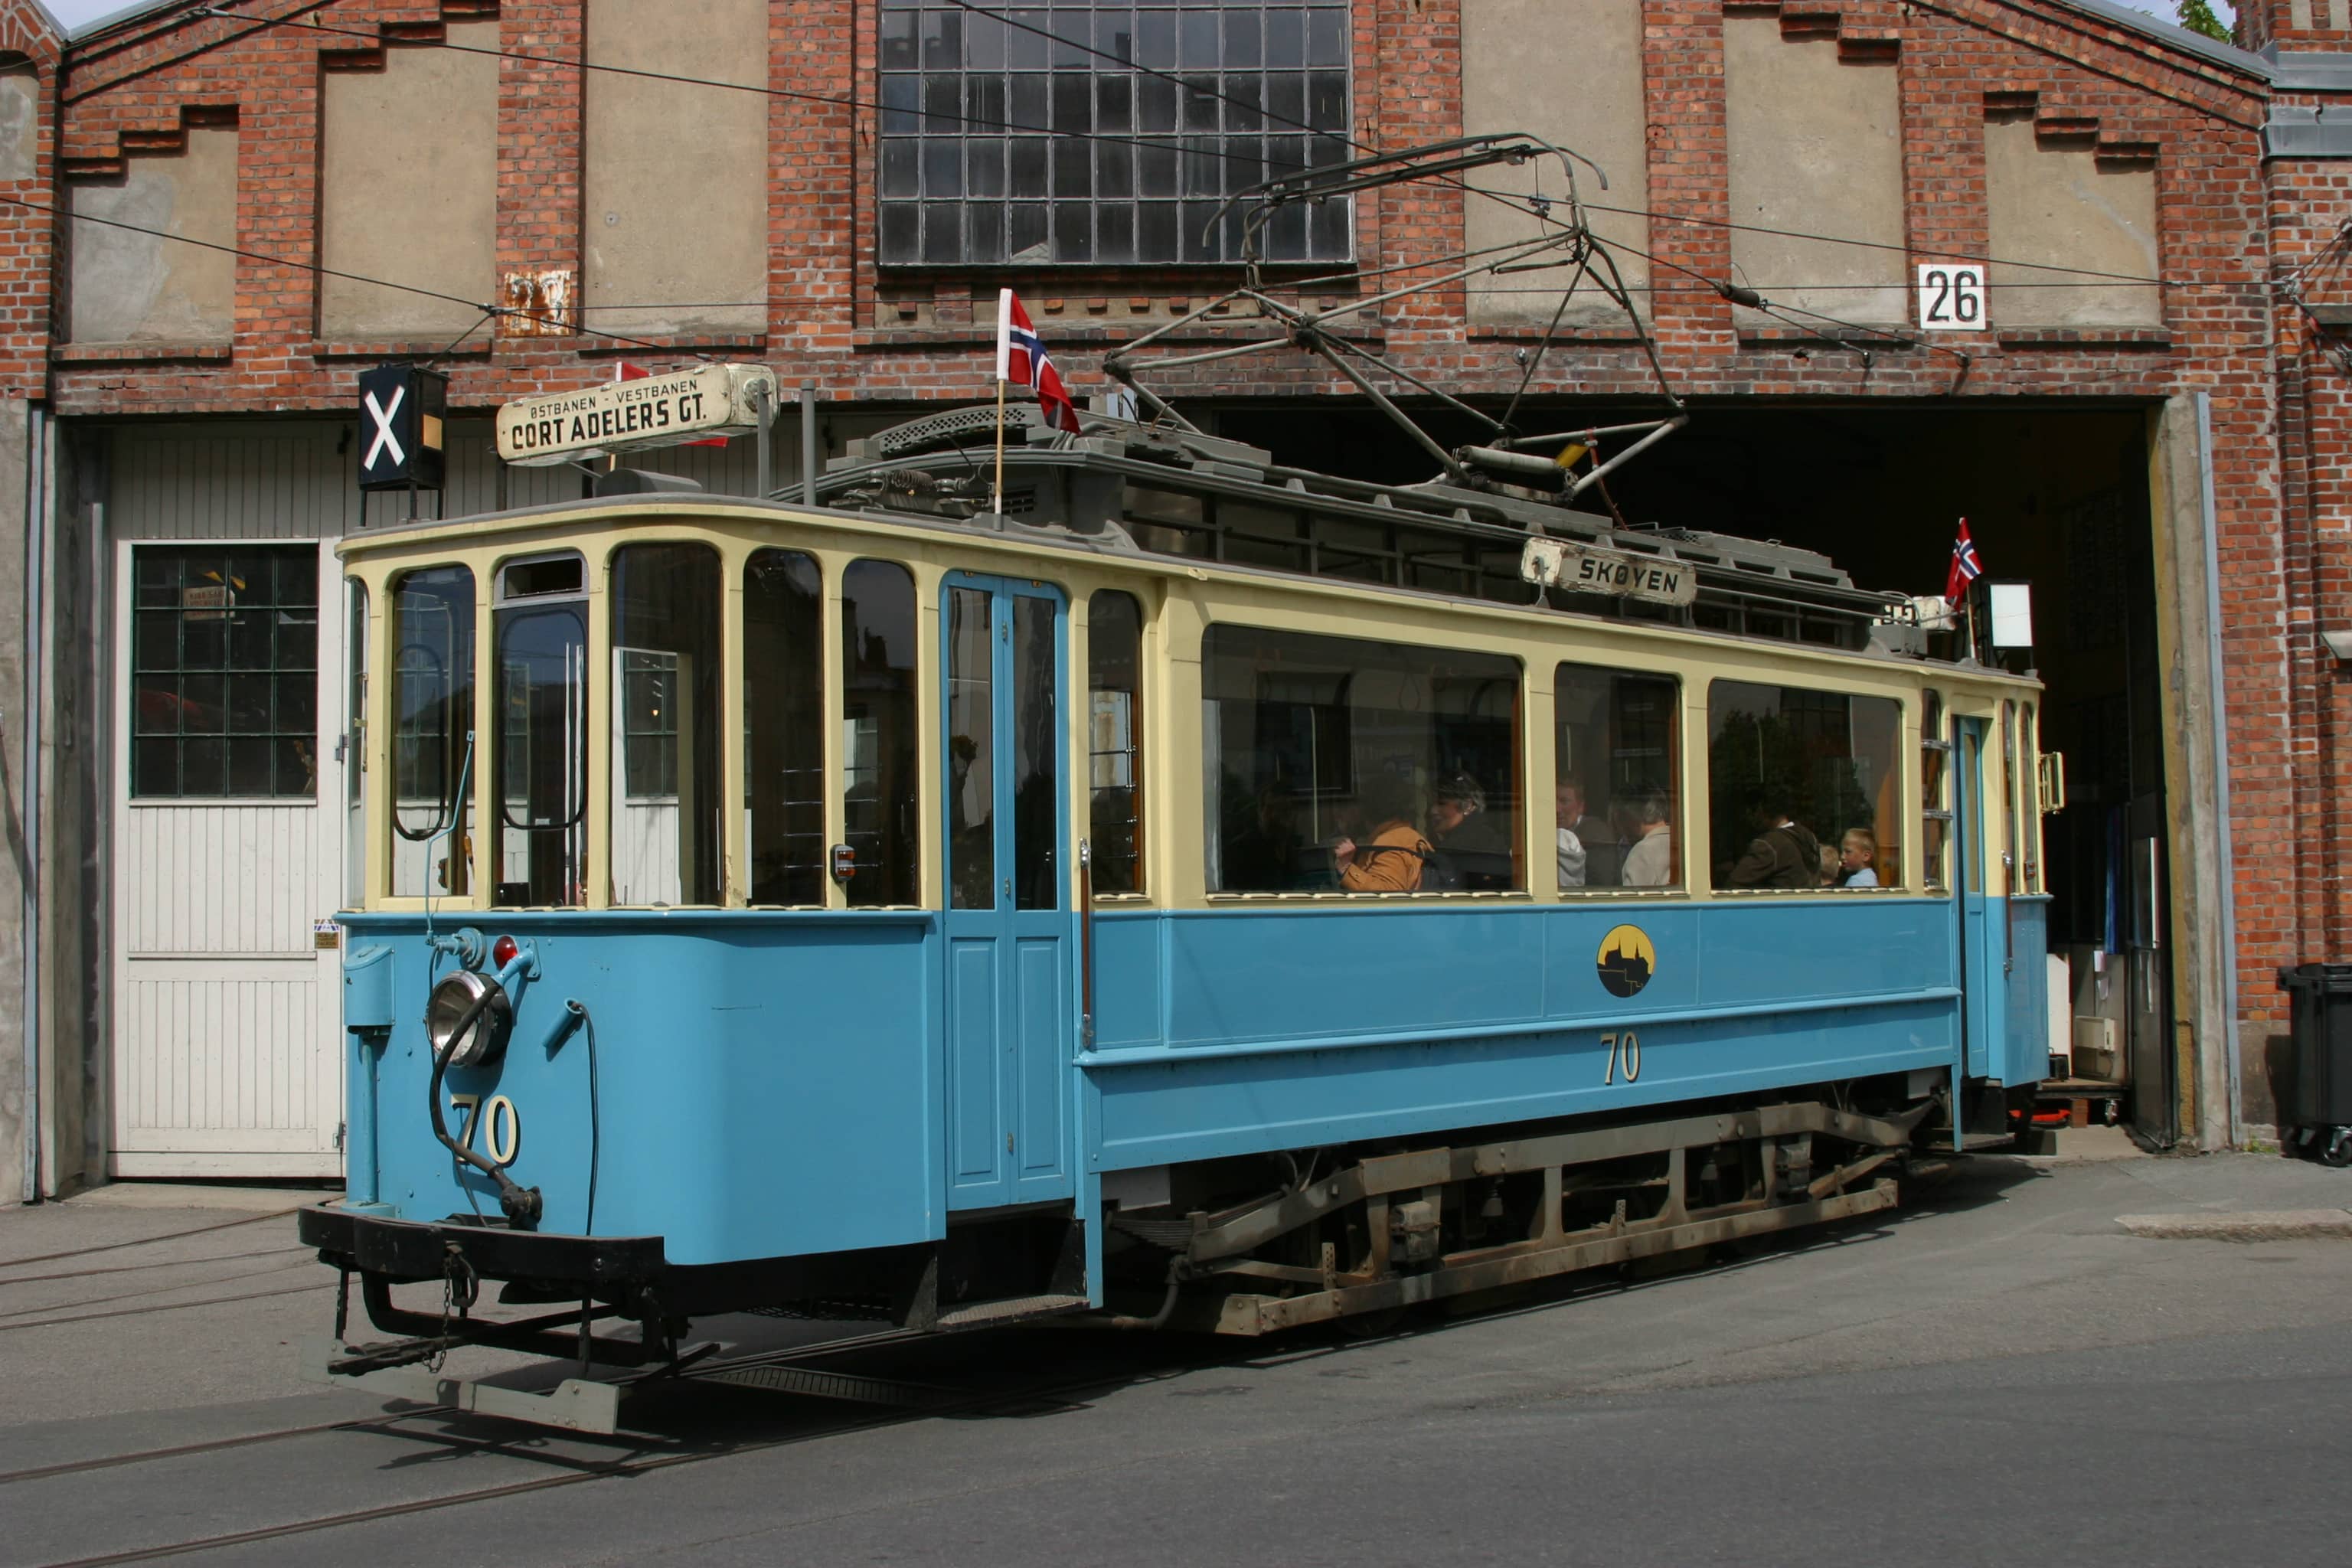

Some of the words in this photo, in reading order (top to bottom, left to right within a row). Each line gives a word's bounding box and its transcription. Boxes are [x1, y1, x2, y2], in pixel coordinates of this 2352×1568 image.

[1926, 270, 1978, 322] 26
[512, 418, 565, 450] CORT
[571, 400, 670, 442] ADELERS
[678, 393, 707, 423] GT.
[531, 396, 596, 419] ØSTBANEN
[616, 380, 697, 403] VESTBANEN
[363, 384, 406, 472] X
[1579, 559, 1678, 593] SKØYEN
[1601, 1031, 1641, 1085] 70
[450, 1094, 521, 1168] 70
